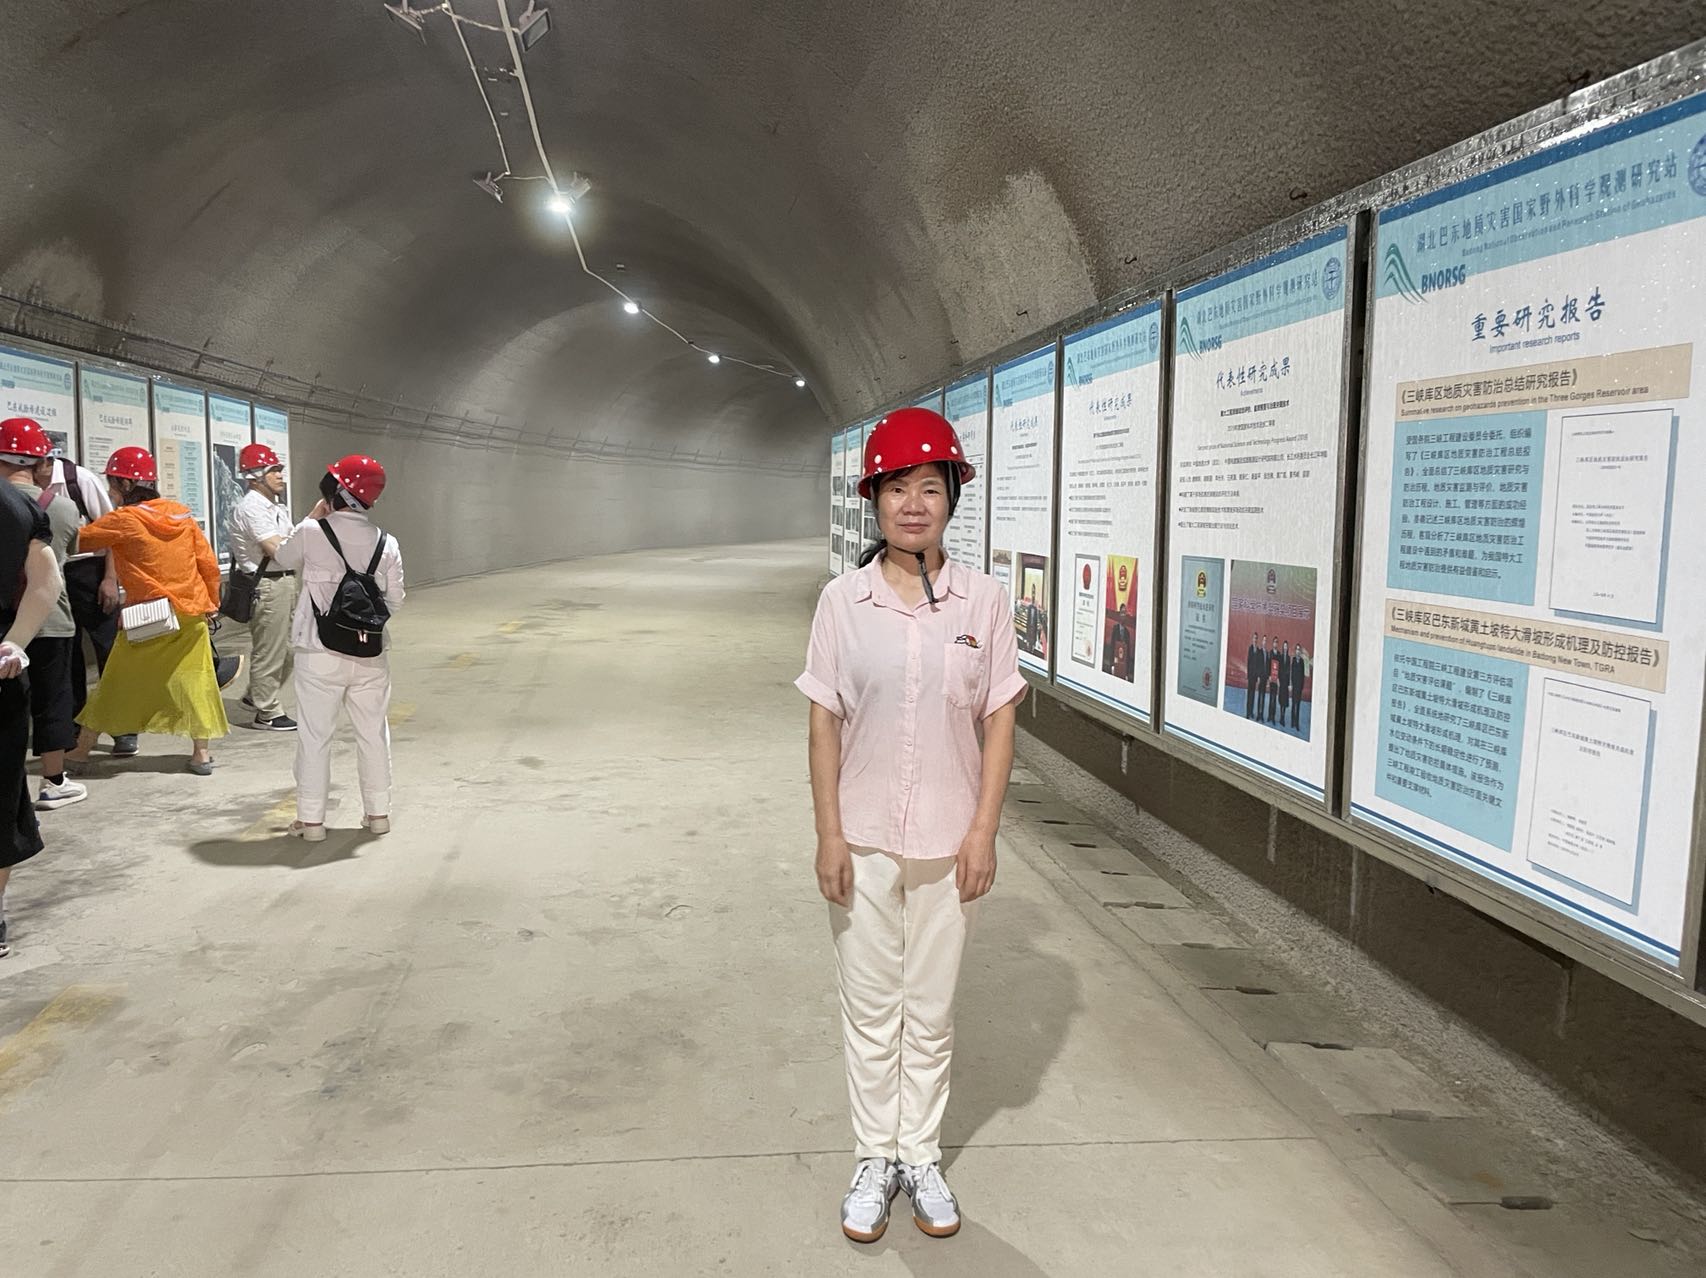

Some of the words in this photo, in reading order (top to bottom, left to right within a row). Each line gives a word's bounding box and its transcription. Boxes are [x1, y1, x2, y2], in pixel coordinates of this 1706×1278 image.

[1421, 264, 1466, 294] BNORSG
[1471, 286, 1605, 342] 重要研究报告
[1489, 341, 1521, 353] Important
[1522, 336, 1553, 349] research
[1554, 332, 1580, 344] reports
[1216, 356, 1291, 390] 代表性研究成果
[1401, 368, 1577, 404] 《三峡库区地质灾害防治总结研究报告》
[1538, 395, 1548, 403] the
[1549, 393, 1568, 402] Three
[1570, 390, 1595, 402] Gorges
[1596, 386, 1631, 398] Reservoir
[1632, 386, 1649, 395] area
[1391, 606, 1660, 668] 《三峡库区巴东新城黄土坡特大滑坡形成机理及防控报告》
[1532, 651, 1556, 664] Badong
[1557, 655, 1572, 665] New
[1573, 658, 1592, 670] Town,
[1594, 662, 1615, 674] TGRA
